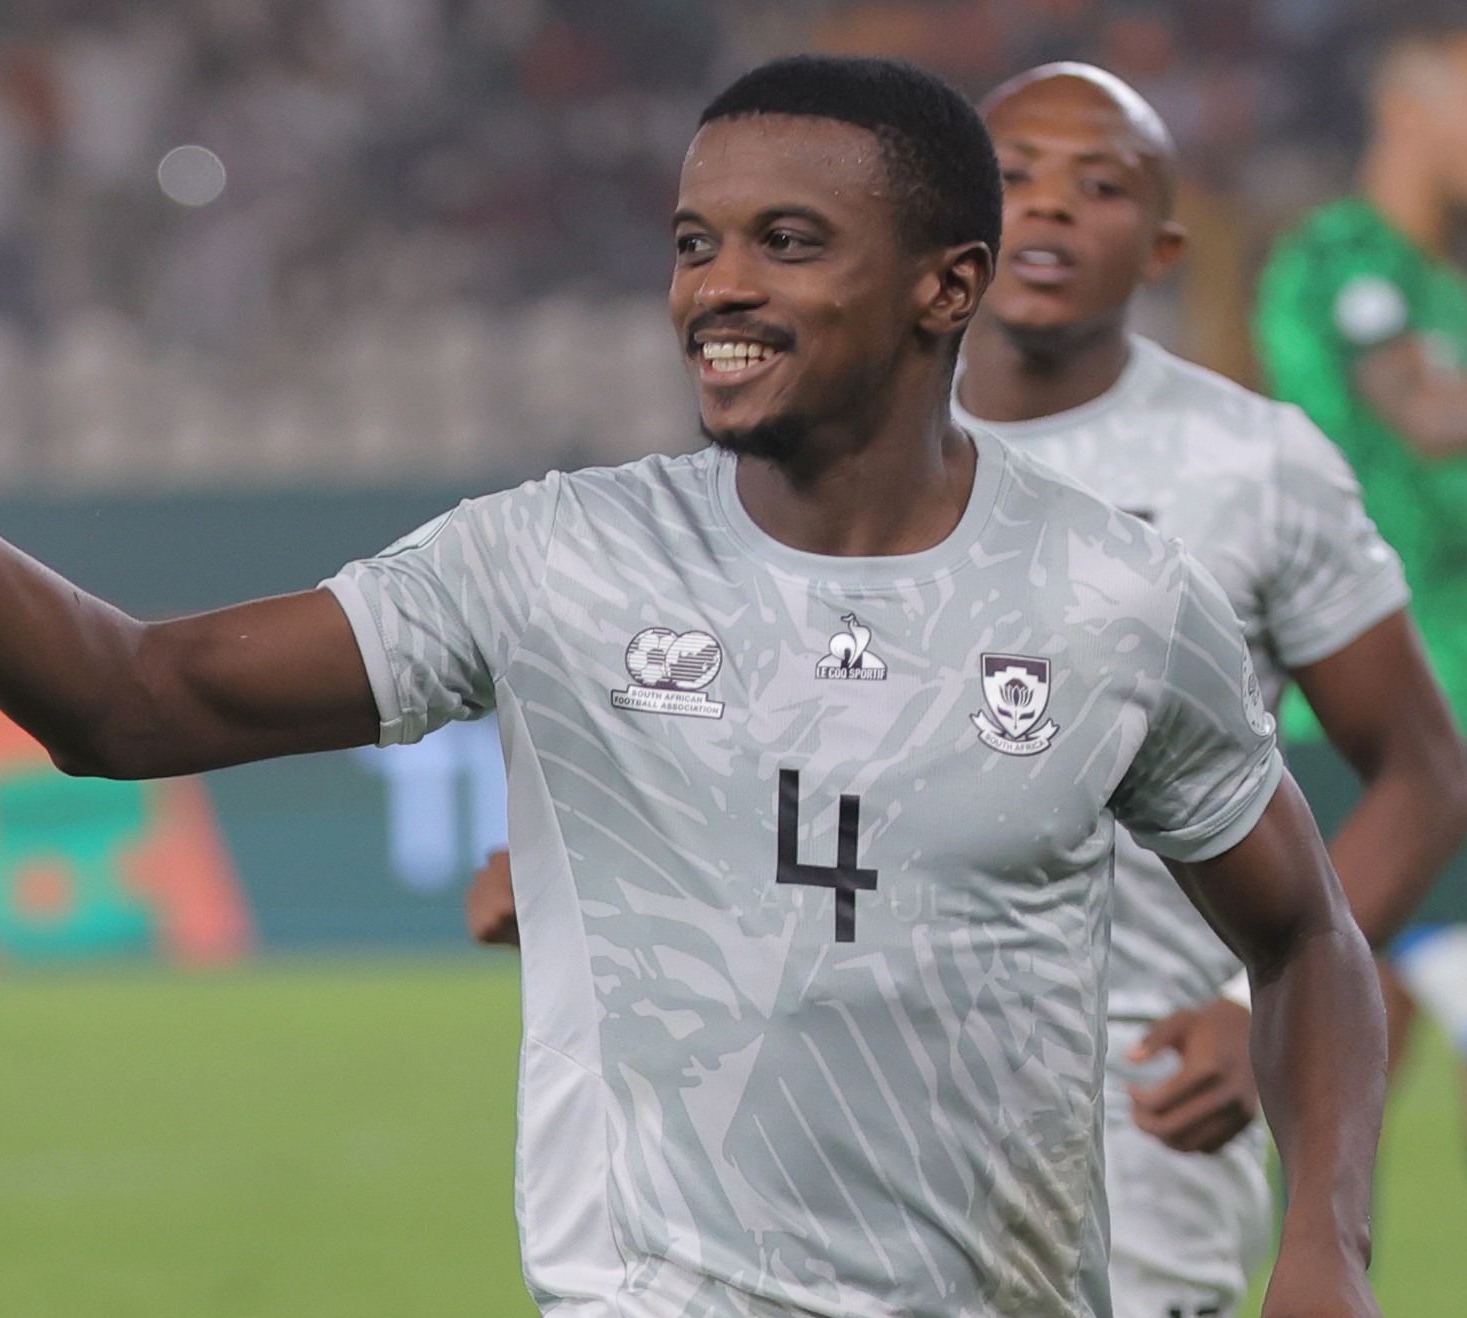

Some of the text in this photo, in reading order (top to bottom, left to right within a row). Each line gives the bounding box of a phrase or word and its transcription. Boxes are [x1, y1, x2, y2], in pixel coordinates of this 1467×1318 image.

[816, 667, 886, 680] LE COQ SPORTIF
[614, 696, 719, 714] FOOTBALL ASSOCIATION
[631, 690, 703, 703] SOUTH AFRICAN
[985, 734, 1045, 751] SOUTH AFRICA
[776, 768, 878, 942] 4
